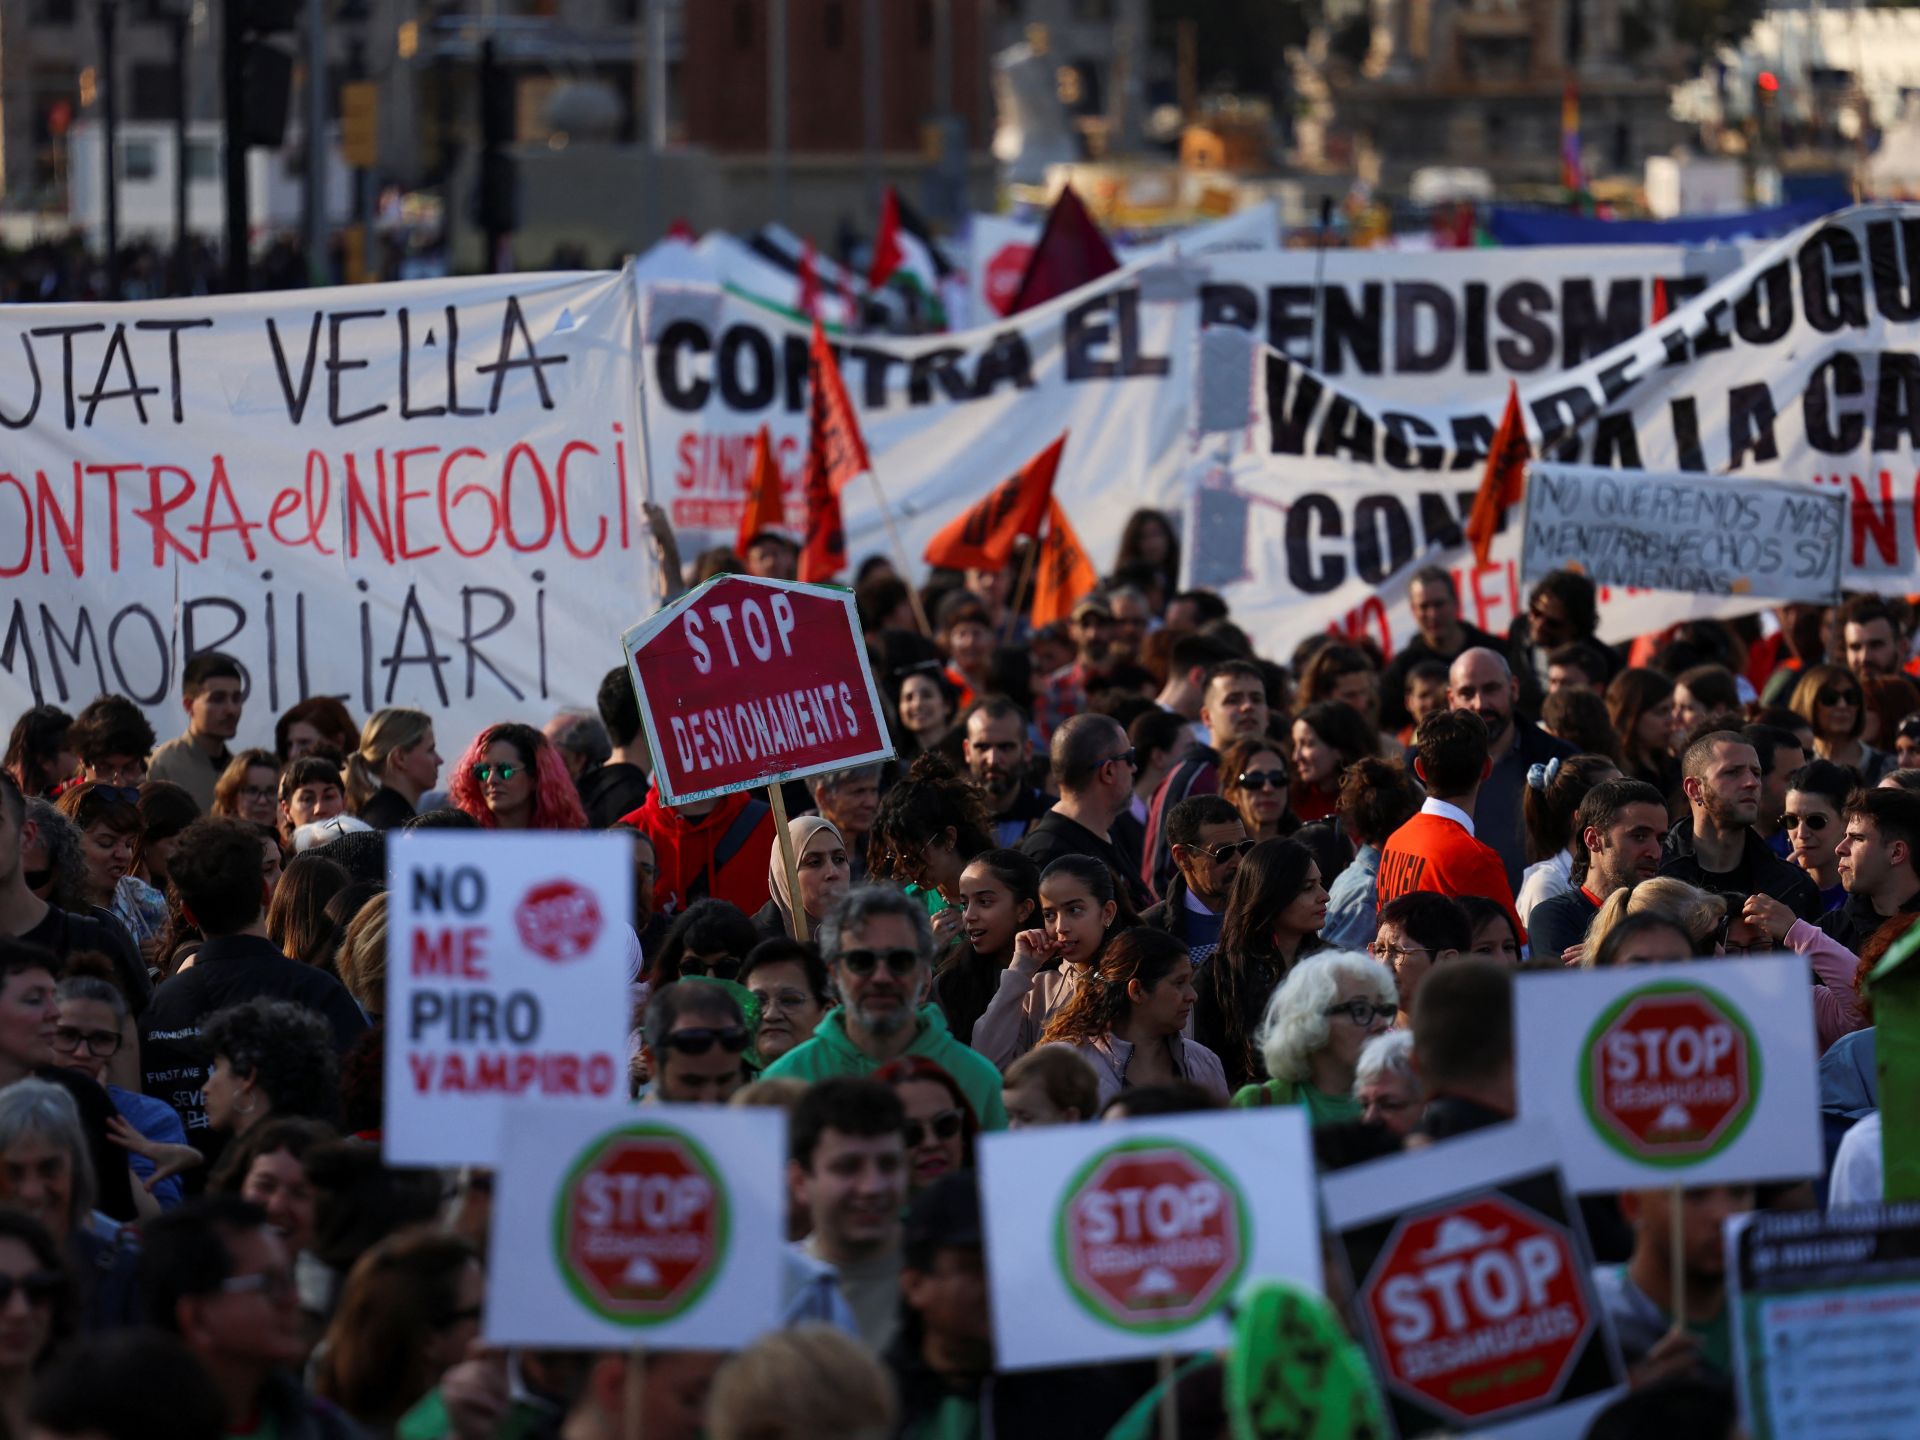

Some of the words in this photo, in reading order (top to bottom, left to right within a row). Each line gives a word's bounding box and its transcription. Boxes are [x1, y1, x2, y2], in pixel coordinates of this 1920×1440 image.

[1065, 285, 1171, 383] EL
[1803, 351, 1920, 455] CA
[344, 423, 630, 565] NEGOCI
[1536, 474, 1581, 515] NO
[683, 593, 795, 675] STOP
[669, 681, 860, 774] DESNONAMENTS
[411, 865, 487, 916] NO
[411, 926, 490, 980] ME
[410, 989, 541, 1045] PIRO
[182, 1067, 200, 1078] AVE
[408, 1052, 615, 1096] VAMPIRO
[1607, 1024, 1733, 1081] STOP
[580, 1171, 711, 1228] STOP
[1081, 1180, 1221, 1244] STOP
[1380, 1233, 1561, 1343] STOP
